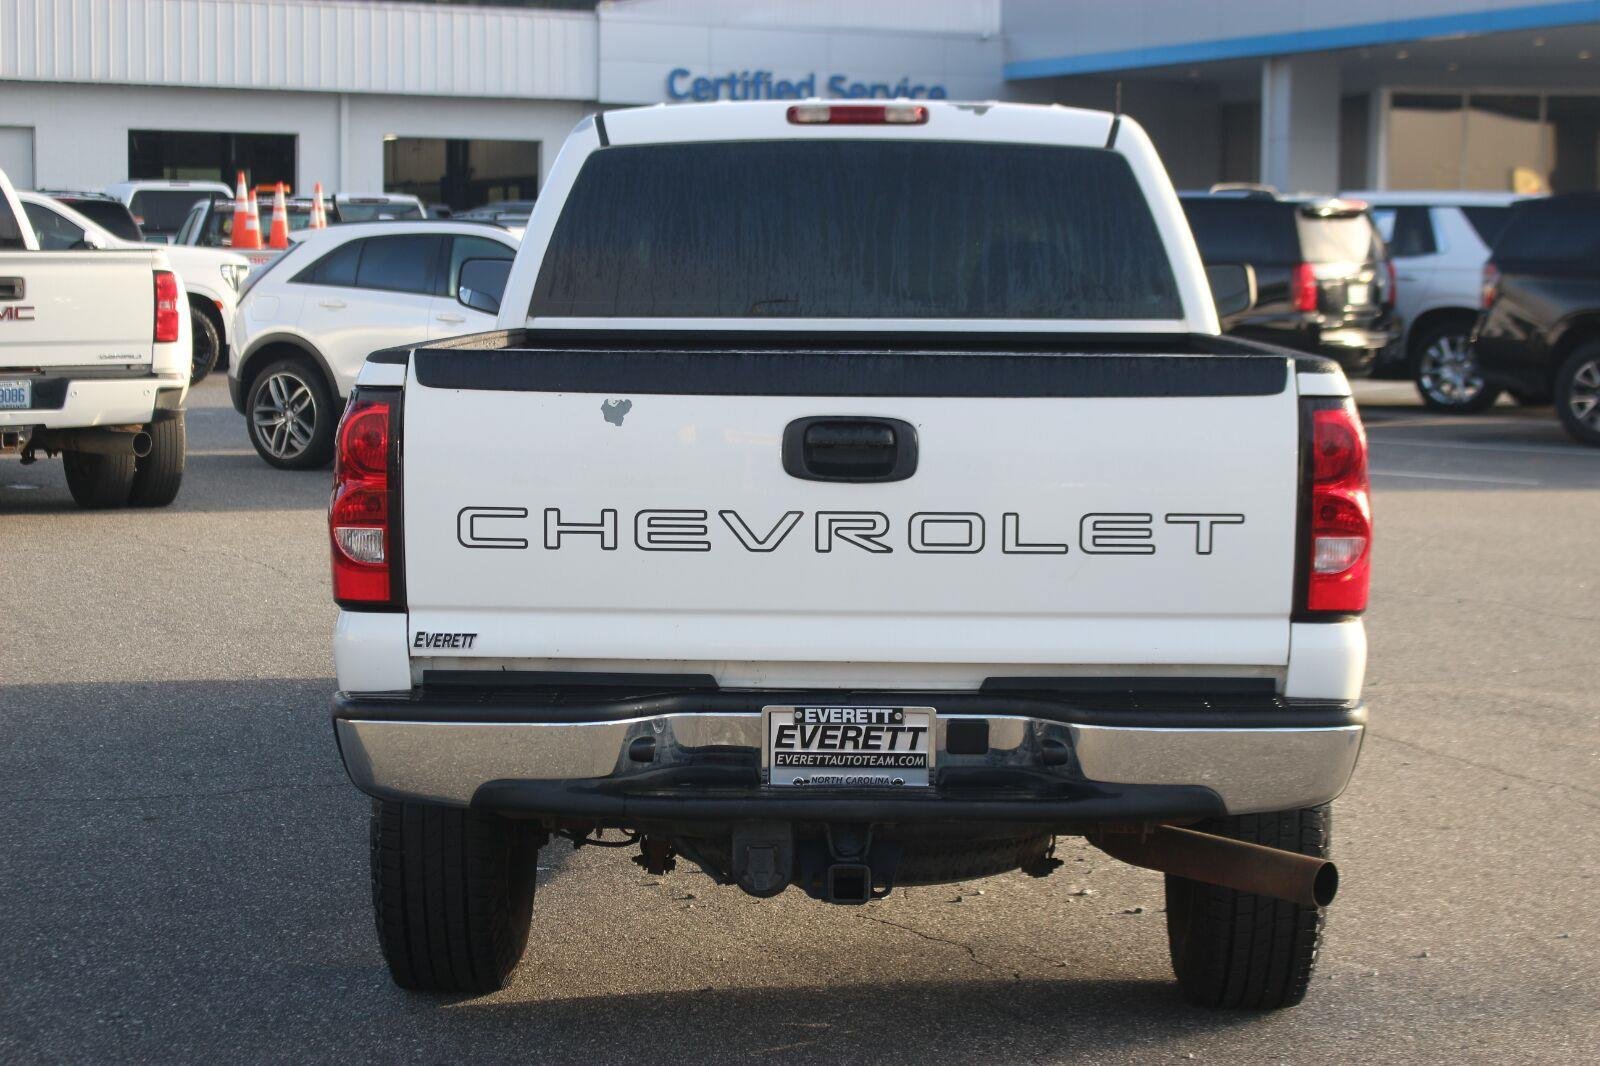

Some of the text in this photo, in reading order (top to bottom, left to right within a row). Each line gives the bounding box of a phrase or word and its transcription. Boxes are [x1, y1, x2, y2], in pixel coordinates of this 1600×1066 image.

[667, 67, 947, 100] Certified Service
[457, 506, 1245, 556] CHEVROLET
[413, 631, 478, 648] EVERETT
[804, 708, 893, 724] EVERETT
[774, 724, 928, 751] EVERETT
[776, 753, 925, 766] EVERETTAUTOTEAM.COM
[811, 776, 890, 785] NORTH CAROLINA
